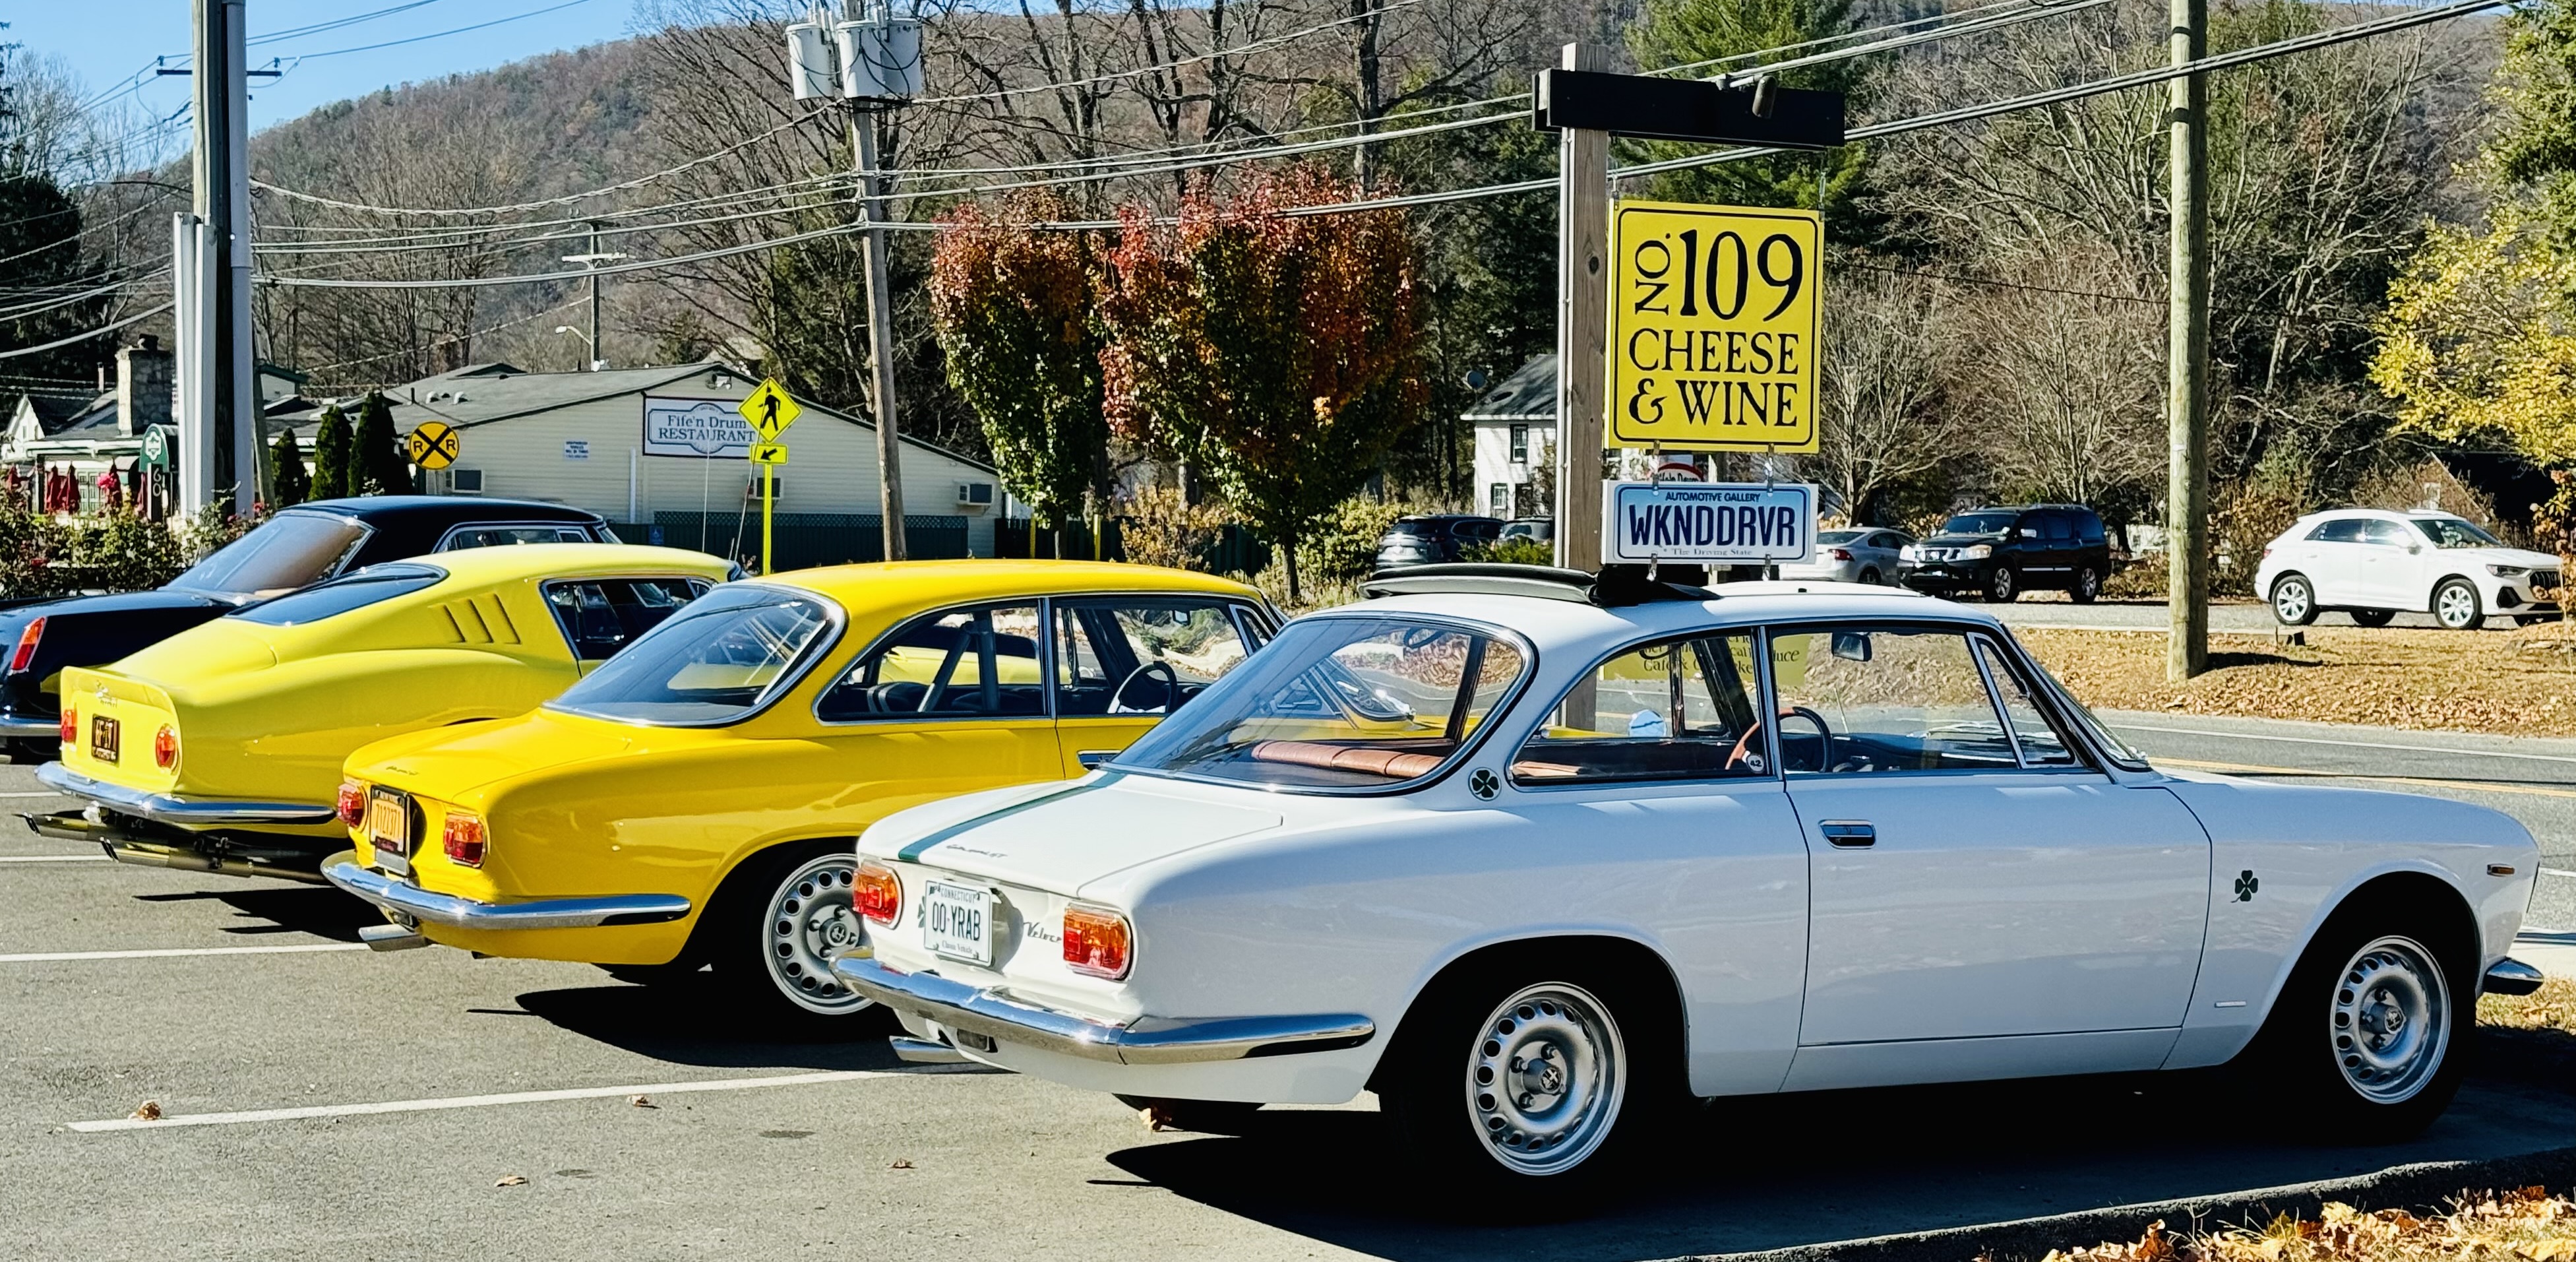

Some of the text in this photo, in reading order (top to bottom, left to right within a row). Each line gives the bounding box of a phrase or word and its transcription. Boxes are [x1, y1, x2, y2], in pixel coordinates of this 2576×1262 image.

[1634, 229, 1803, 322] NO. 109
[1629, 328, 1799, 375] CHEESE
[1629, 378, 1798, 427] & WINE
[658, 427, 756, 443] RESTAURANT
[709, 416, 747, 429] Drum
[153, 468, 162, 497] 60
[1665, 491, 1761, 503] AUTOMOTIVE GALLERY
[1629, 504, 1795, 547] WKNDDRVR
[941, 887, 977, 904] CONNECTICUT
